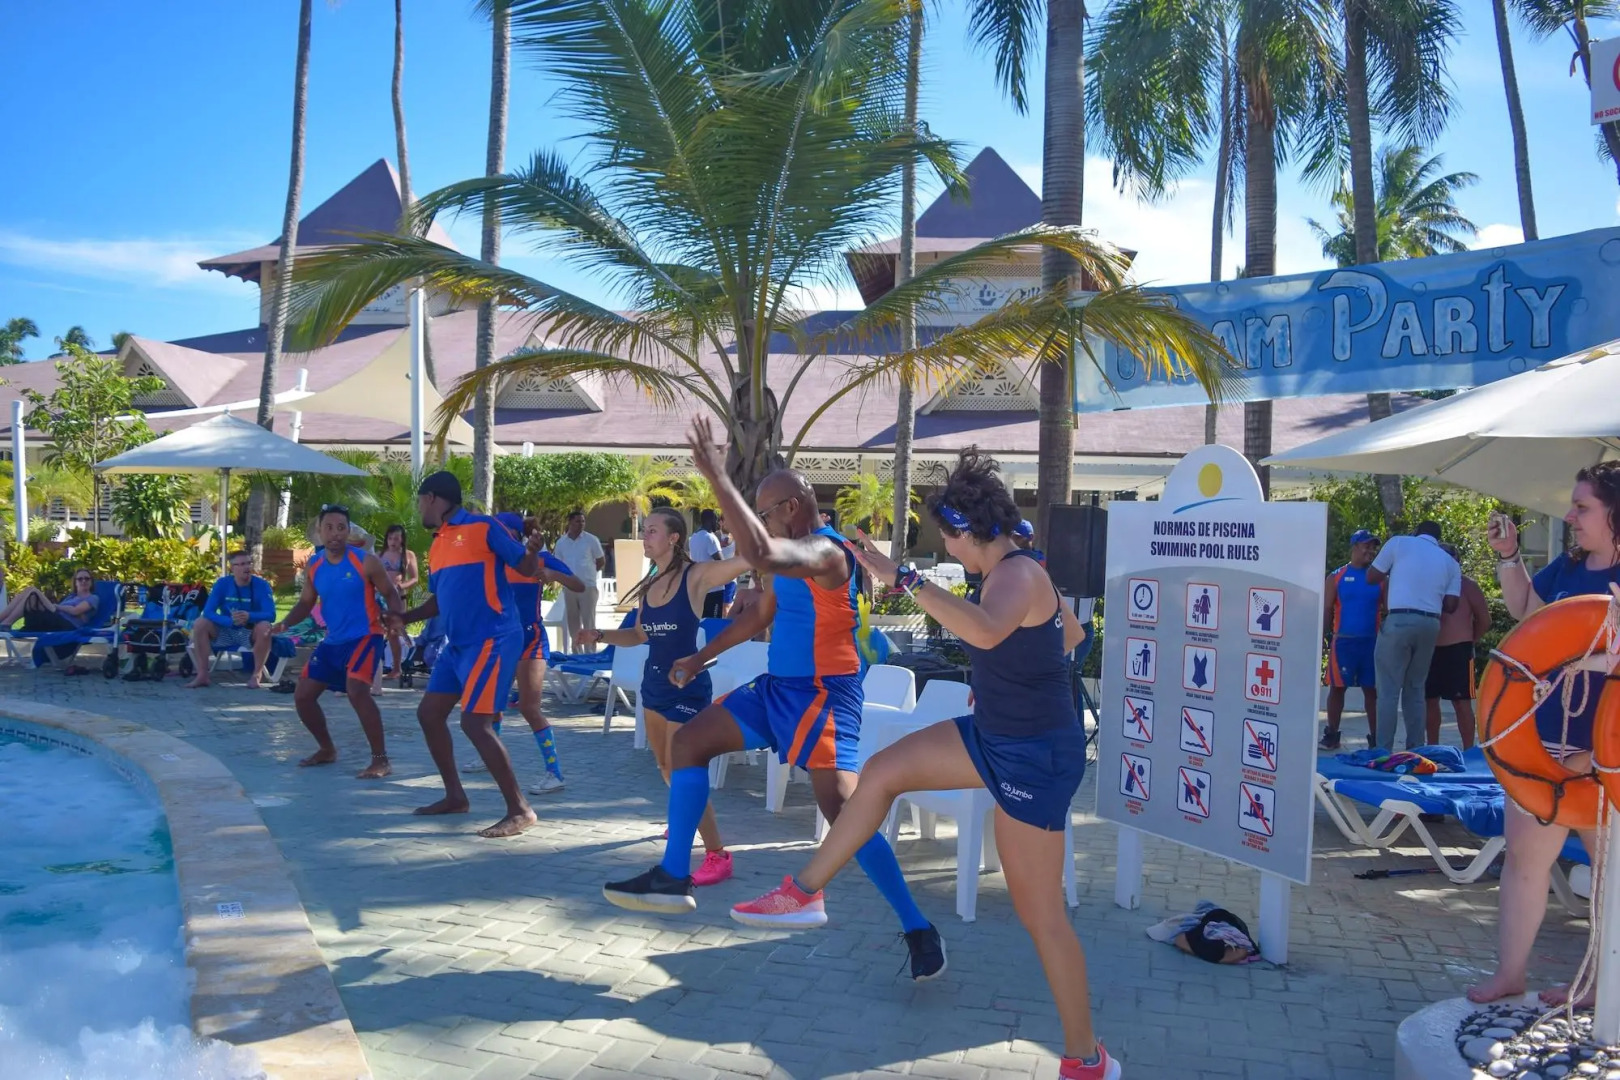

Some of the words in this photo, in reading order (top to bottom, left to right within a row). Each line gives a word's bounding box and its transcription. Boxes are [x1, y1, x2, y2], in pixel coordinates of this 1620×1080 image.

[1594, 110, 1604, 119] NO
[1604, 107, 1620, 117] SOC
[1153, 520, 1196, 537] NORMAS
[1198, 521, 1211, 537] DE
[1212, 522, 1255, 539] PISCINA
[1150, 541, 1197, 558] SWIMING
[1199, 543, 1225, 560] POOL
[1227, 544, 1260, 561] RULES
[652, 621, 678, 633] jumbo
[1260, 687, 1272, 698] 911
[1010, 786, 1033, 800] jumbo
